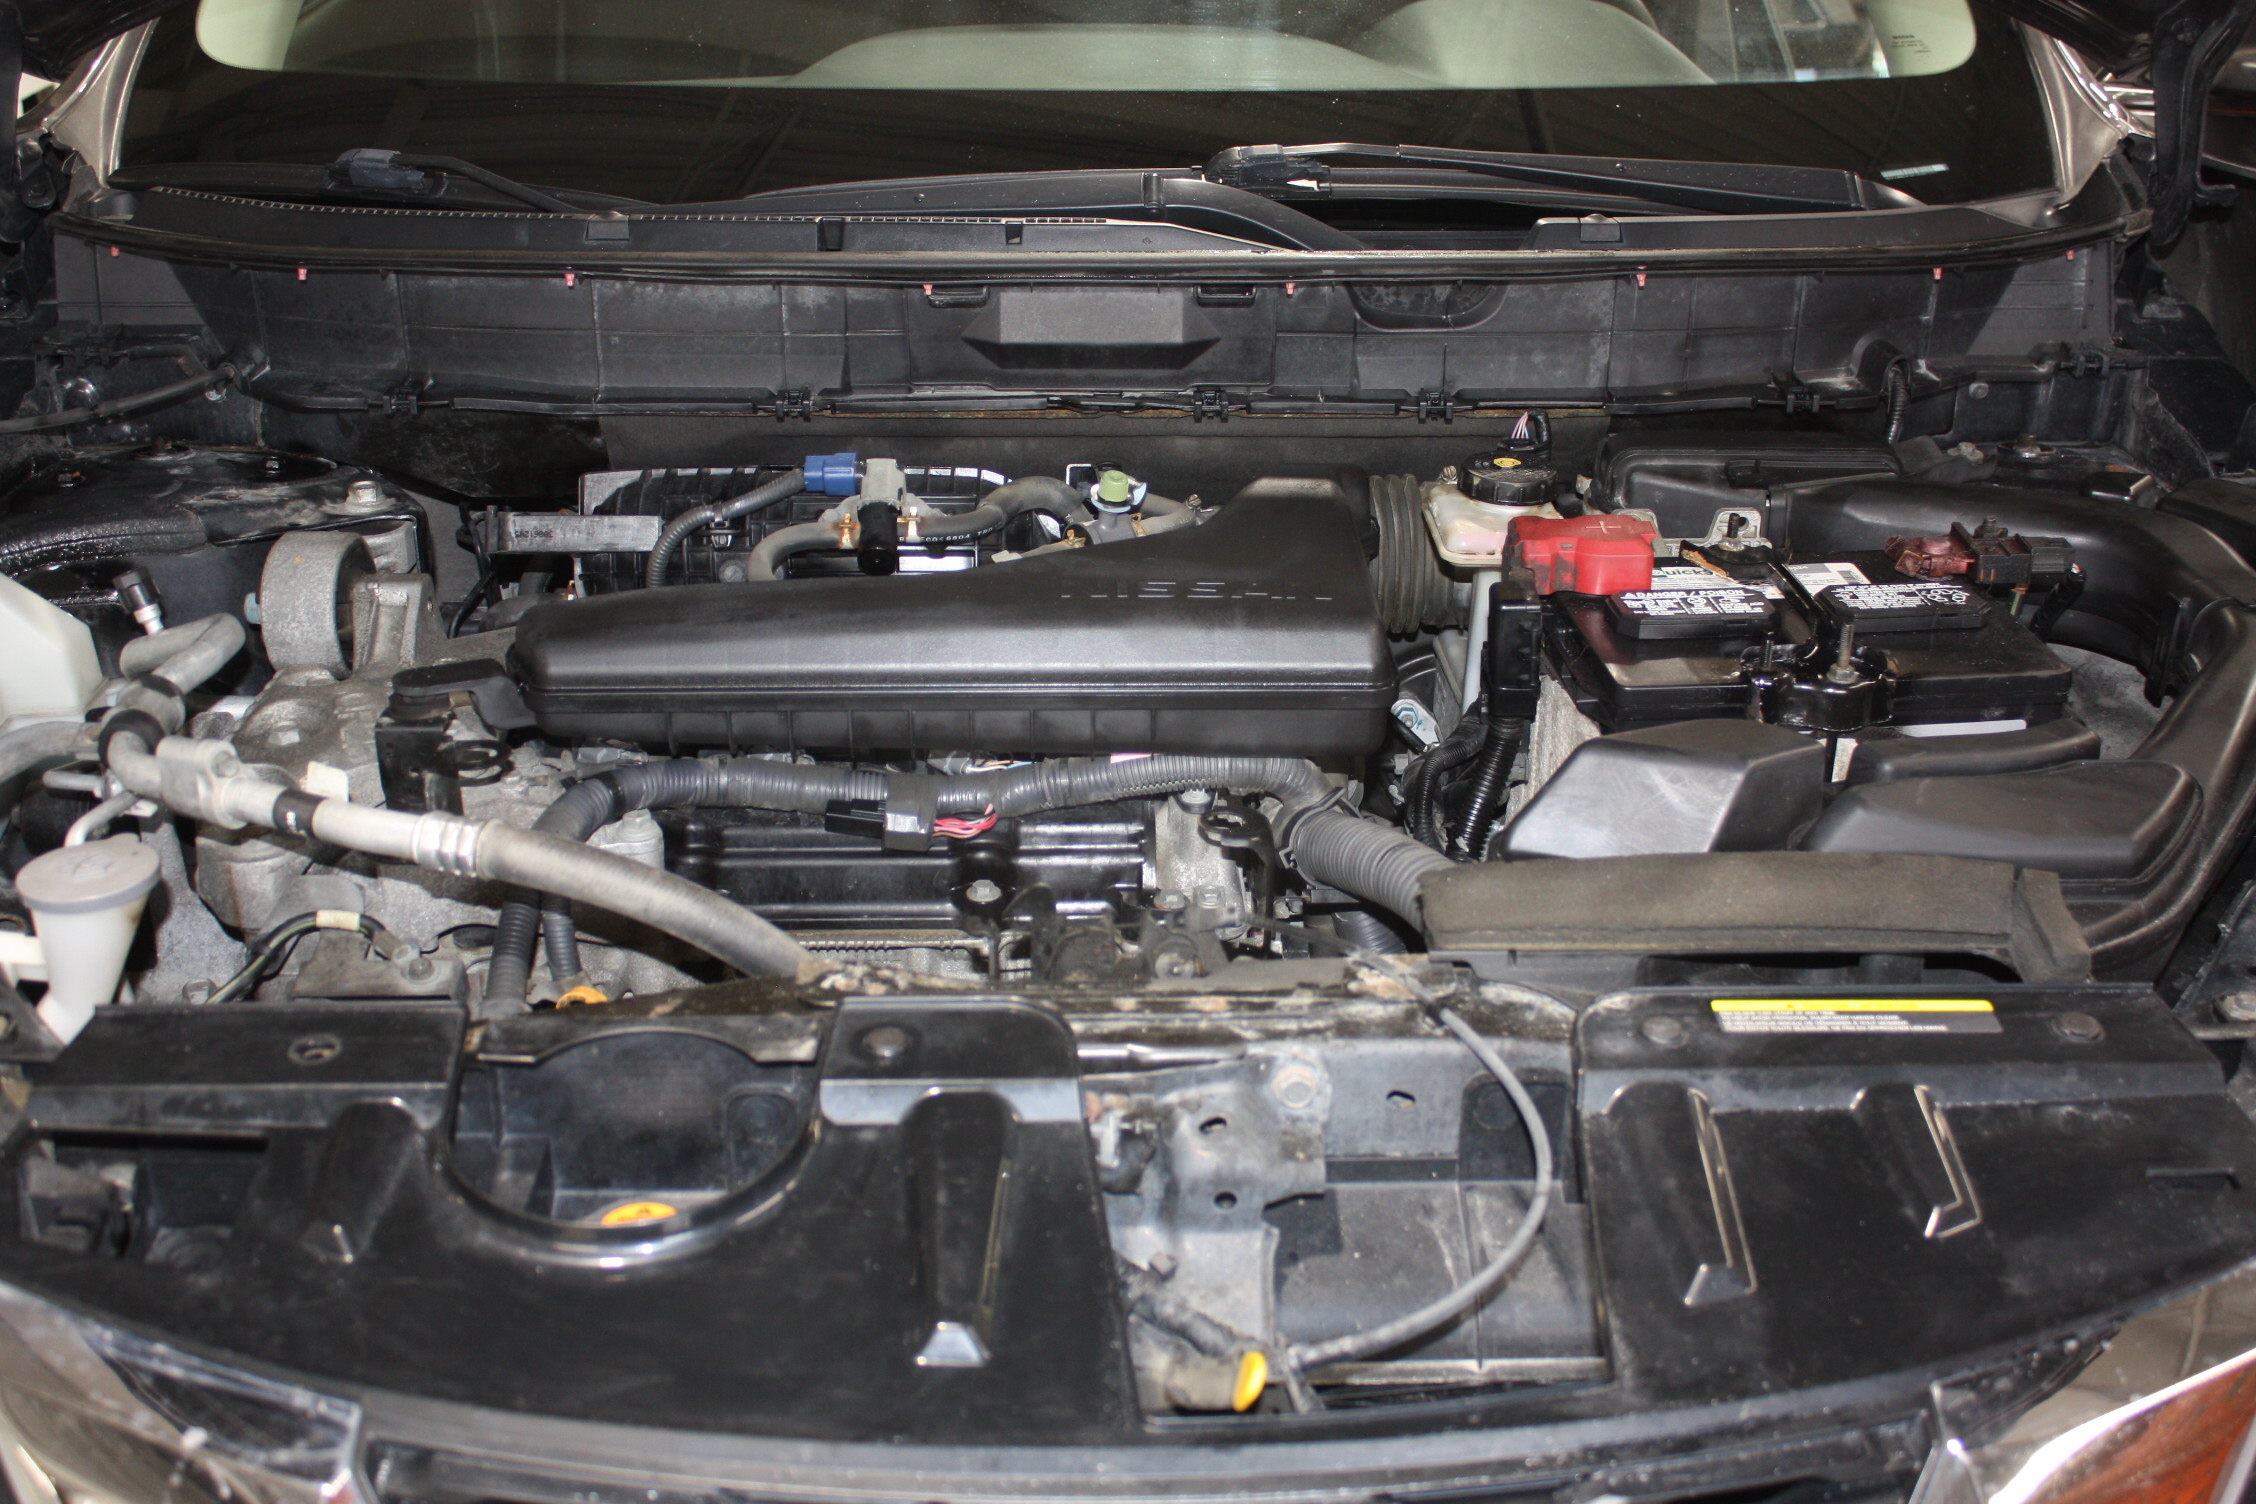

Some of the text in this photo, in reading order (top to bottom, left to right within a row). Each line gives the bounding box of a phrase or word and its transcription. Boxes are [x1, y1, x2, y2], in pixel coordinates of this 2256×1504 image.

[1060, 581, 1333, 600] NISSAN
[1636, 591, 1686, 599] DANGER
[1699, 589, 1745, 597] POISON
